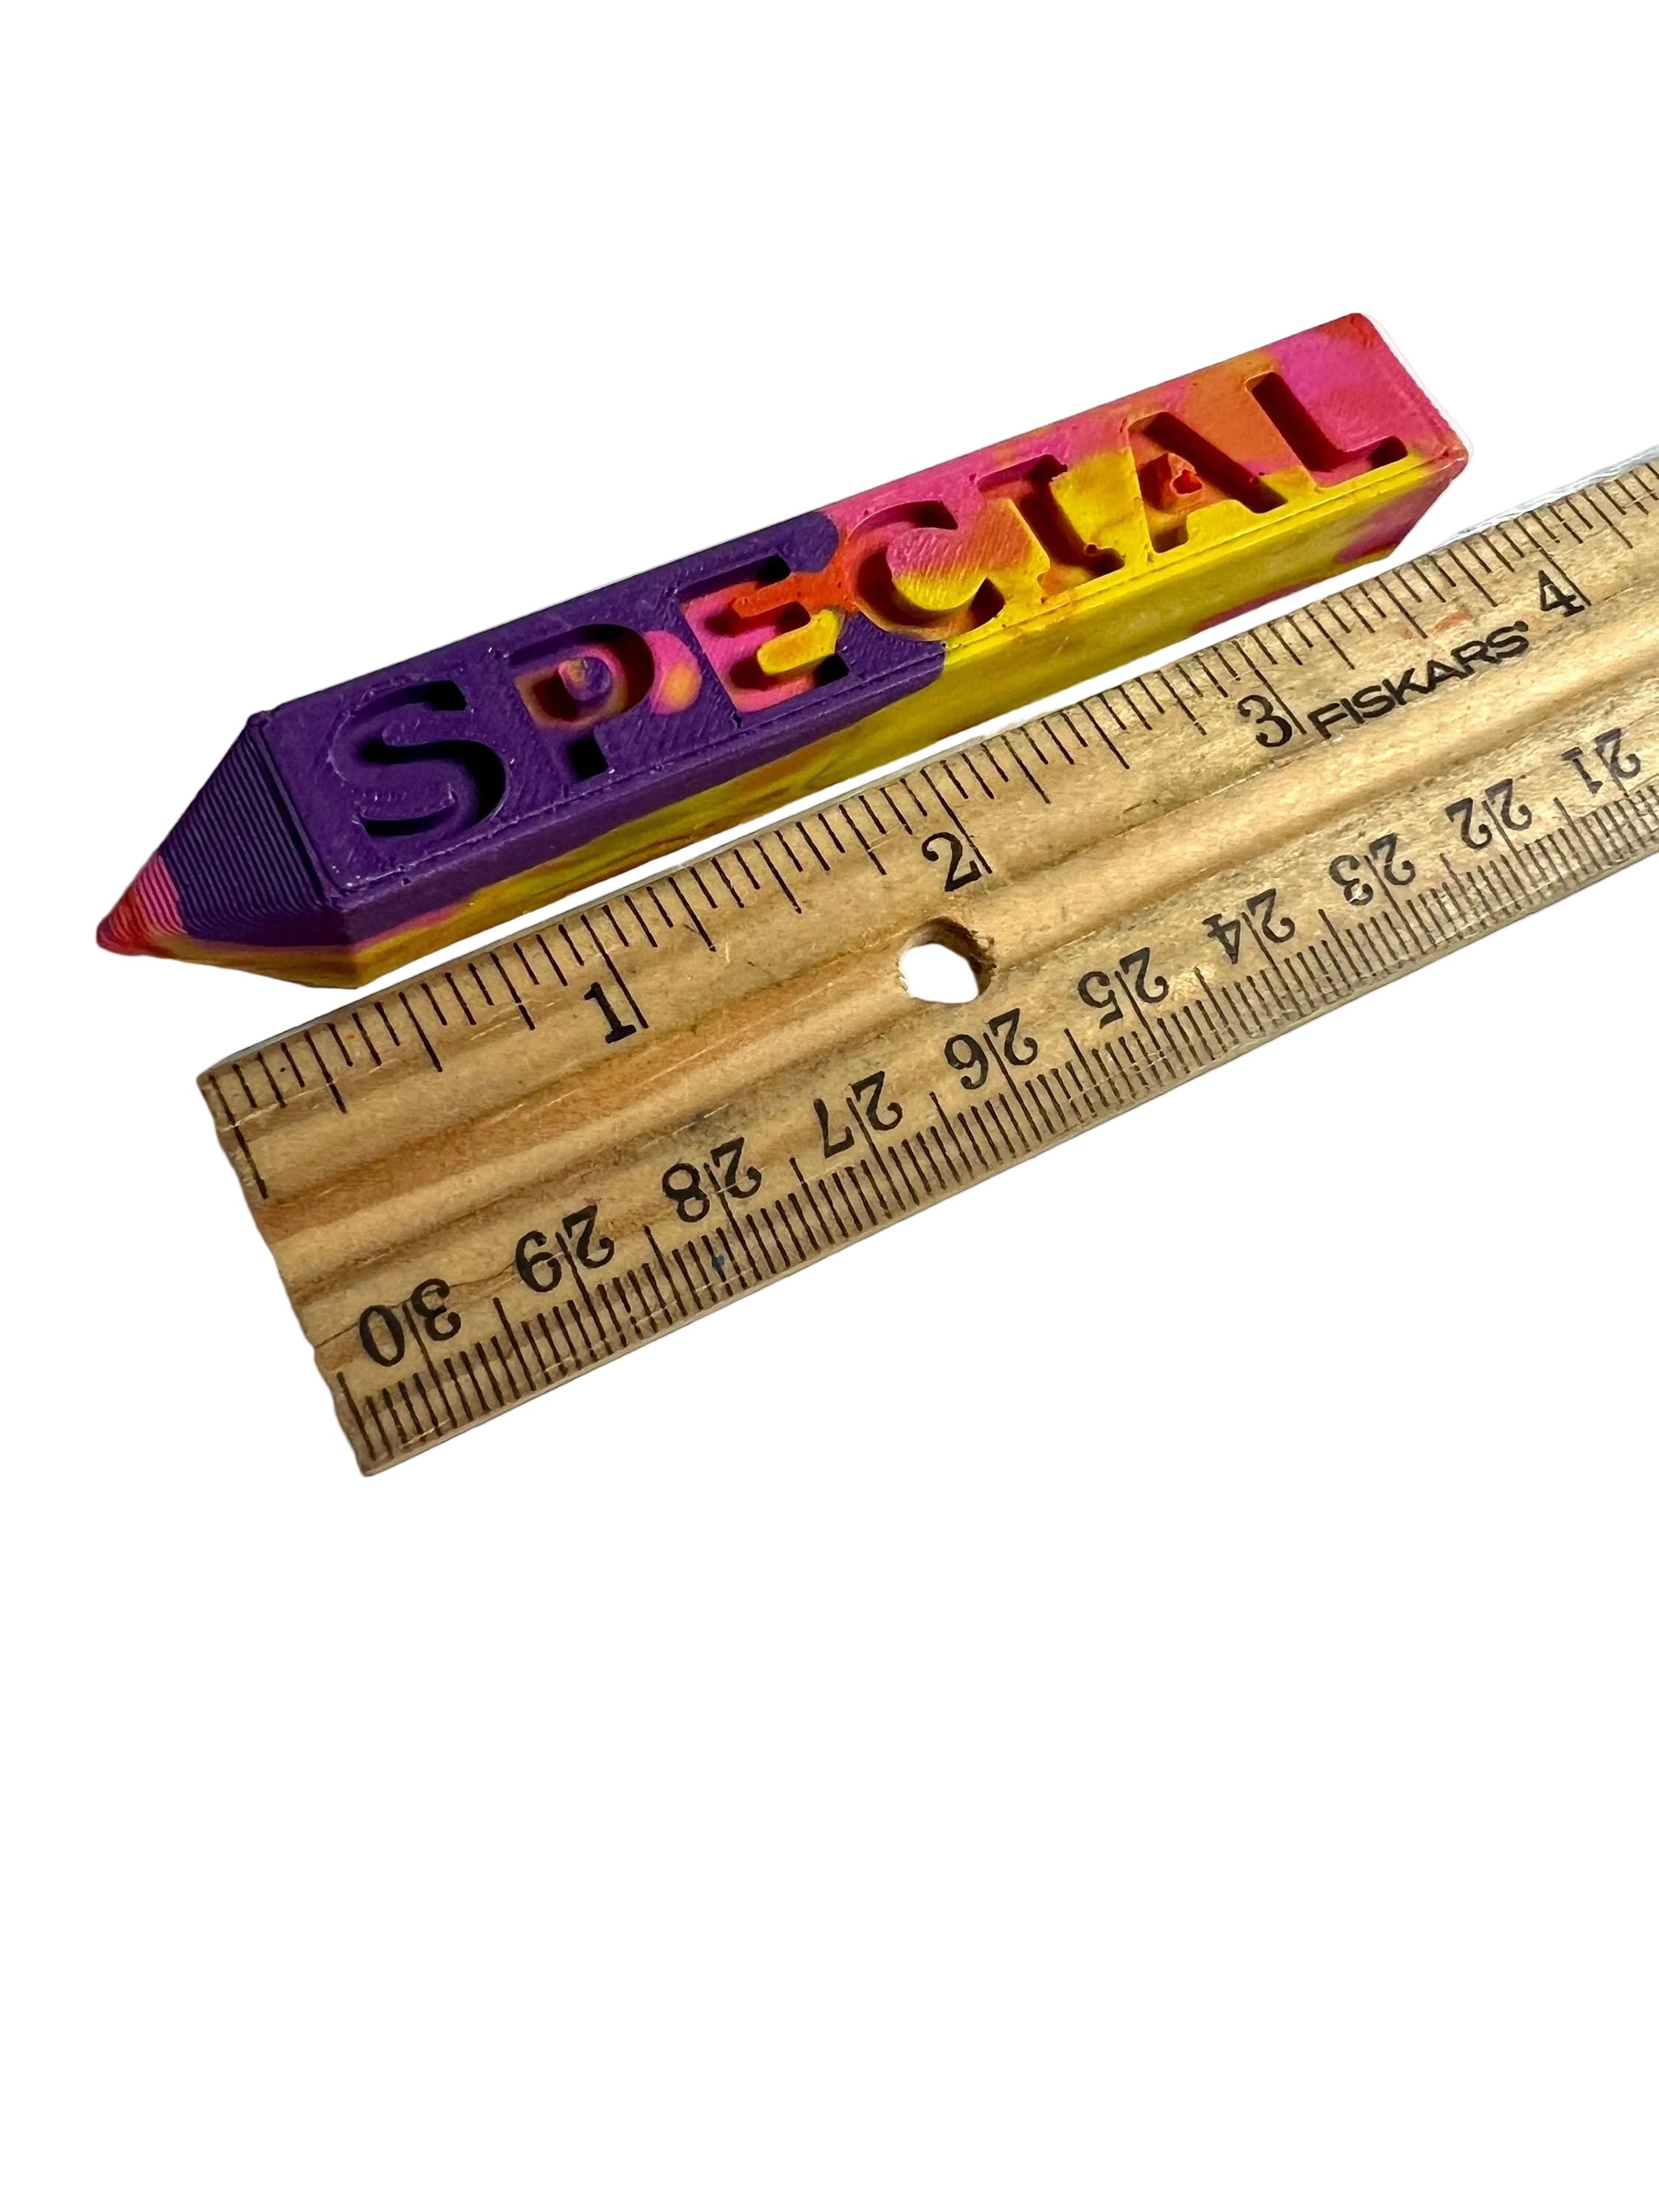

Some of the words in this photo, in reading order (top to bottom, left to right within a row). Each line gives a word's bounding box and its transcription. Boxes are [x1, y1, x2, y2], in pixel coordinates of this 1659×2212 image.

[330, 370, 1408, 838] SPECIAL
[1537, 569, 1586, 618] 4
[1237, 693, 1293, 748] 3
[1307, 622, 1531, 740] FISKARS
[1561, 728, 1641, 795] 21
[1444, 778, 1532, 850] 22
[921, 831, 982, 892] 2
[1328, 832, 1416, 906] 23
[1202, 888, 1295, 964] 24
[583, 982, 636, 1044] 1
[1077, 947, 1169, 1029] 25
[944, 1007, 1038, 1090] 26
[813, 1070, 903, 1158] 27
[661, 1137, 762, 1223] 28
[514, 1204, 615, 1294] 29
[358, 1278, 462, 1368] 30
